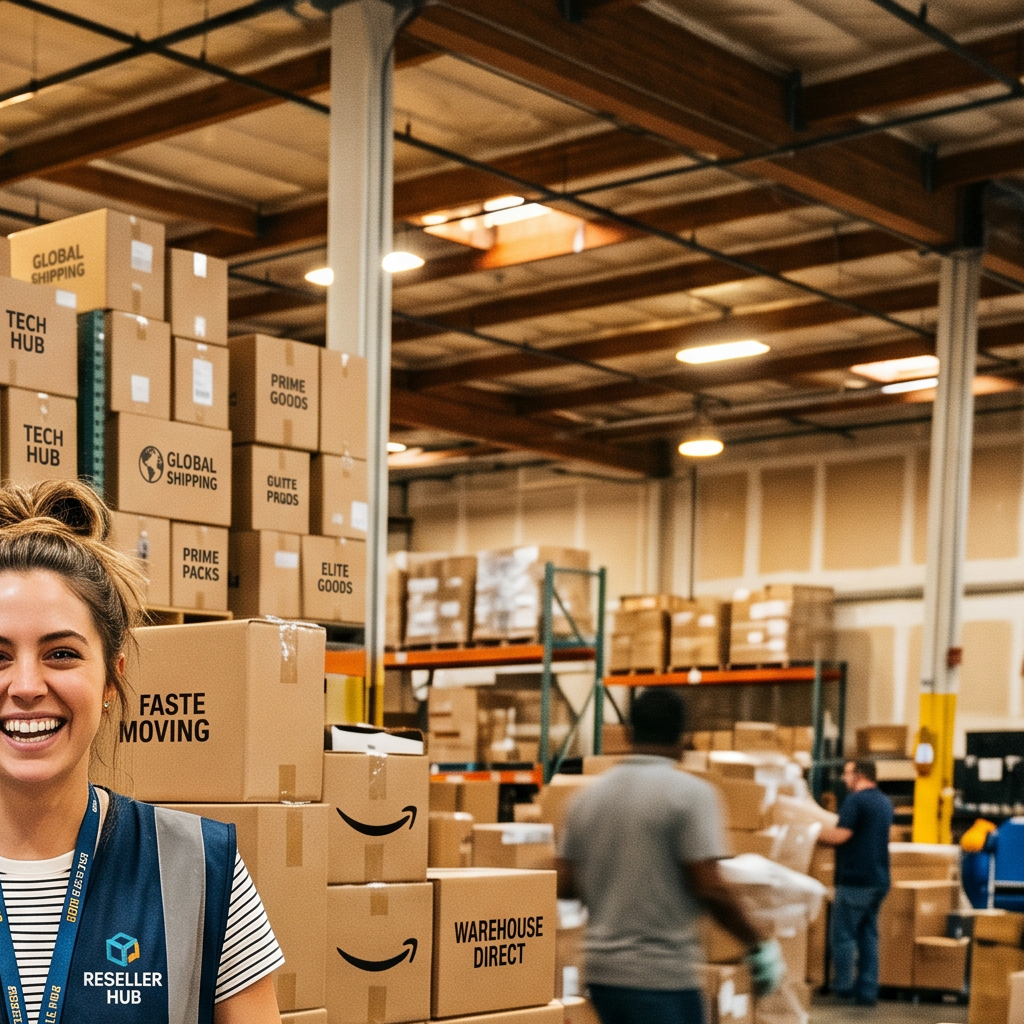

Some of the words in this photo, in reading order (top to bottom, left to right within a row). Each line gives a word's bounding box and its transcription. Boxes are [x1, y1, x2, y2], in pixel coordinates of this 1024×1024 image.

[32, 244, 84, 270] GLOBAL
[31, 262, 85, 284] SHIPPING
[6, 309, 46, 335] TECH
[10, 331, 45, 354] HUB
[270, 373, 306, 394] PRIME
[269, 390, 308, 411] GOODS
[23, 424, 64, 447] TECH
[26, 445, 61, 467] HUB
[167, 451, 217, 474] GLOBAL
[166, 470, 218, 492] SHIPPING
[182, 547, 220, 566] PRIME
[182, 564, 220, 582] PACKS
[321, 562, 349, 578] ELITE
[317, 578, 353, 595] GOODS
[139, 692, 206, 717] FASTE
[119, 718, 210, 743] MOVING
[454, 916, 544, 944] WAREHOUSE
[473, 942, 526, 969] DIRECT
[82, 971, 163, 987] RESELLER
[106, 989, 142, 1005] HUB
